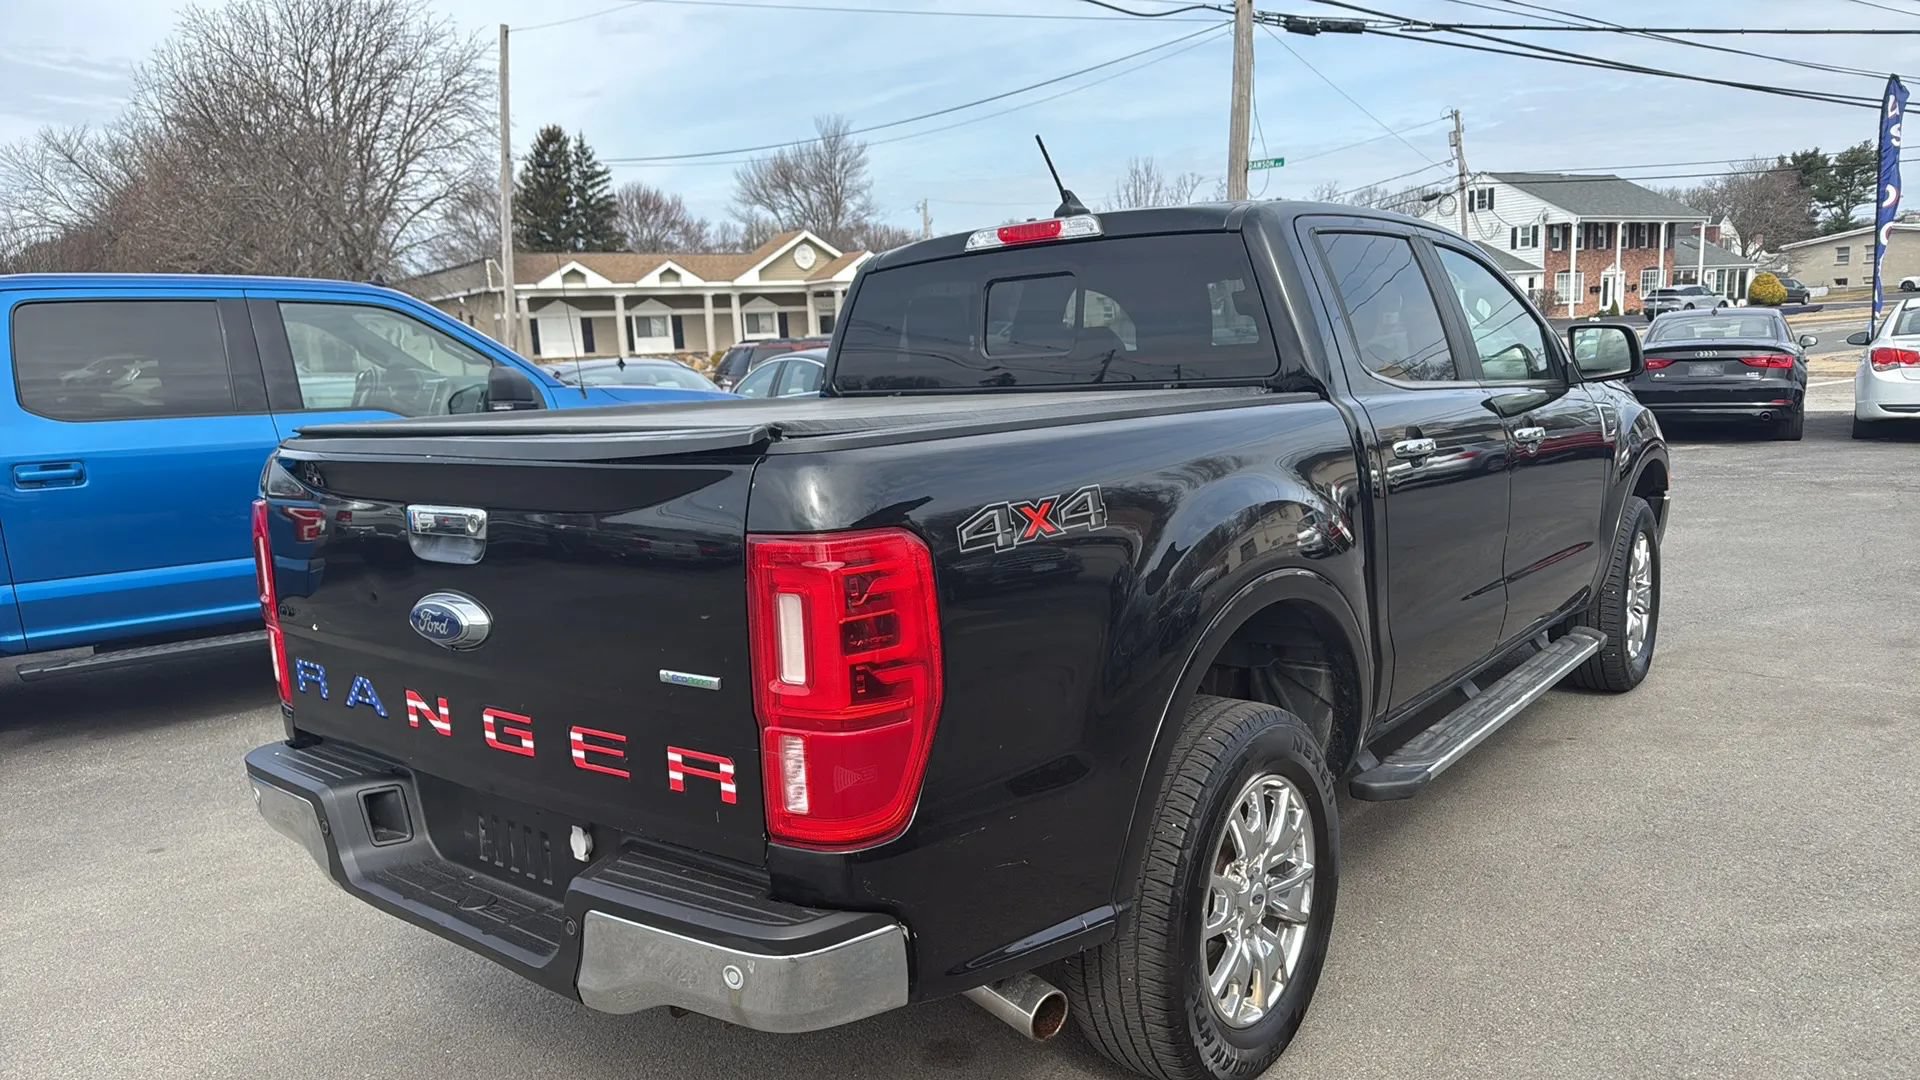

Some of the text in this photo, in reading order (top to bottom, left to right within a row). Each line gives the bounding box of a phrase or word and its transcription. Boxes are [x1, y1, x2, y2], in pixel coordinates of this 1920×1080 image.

[418, 608, 449, 635] Ford
[294, 657, 737, 805] RANGER
[1291, 735, 1335, 806] NEXEN
